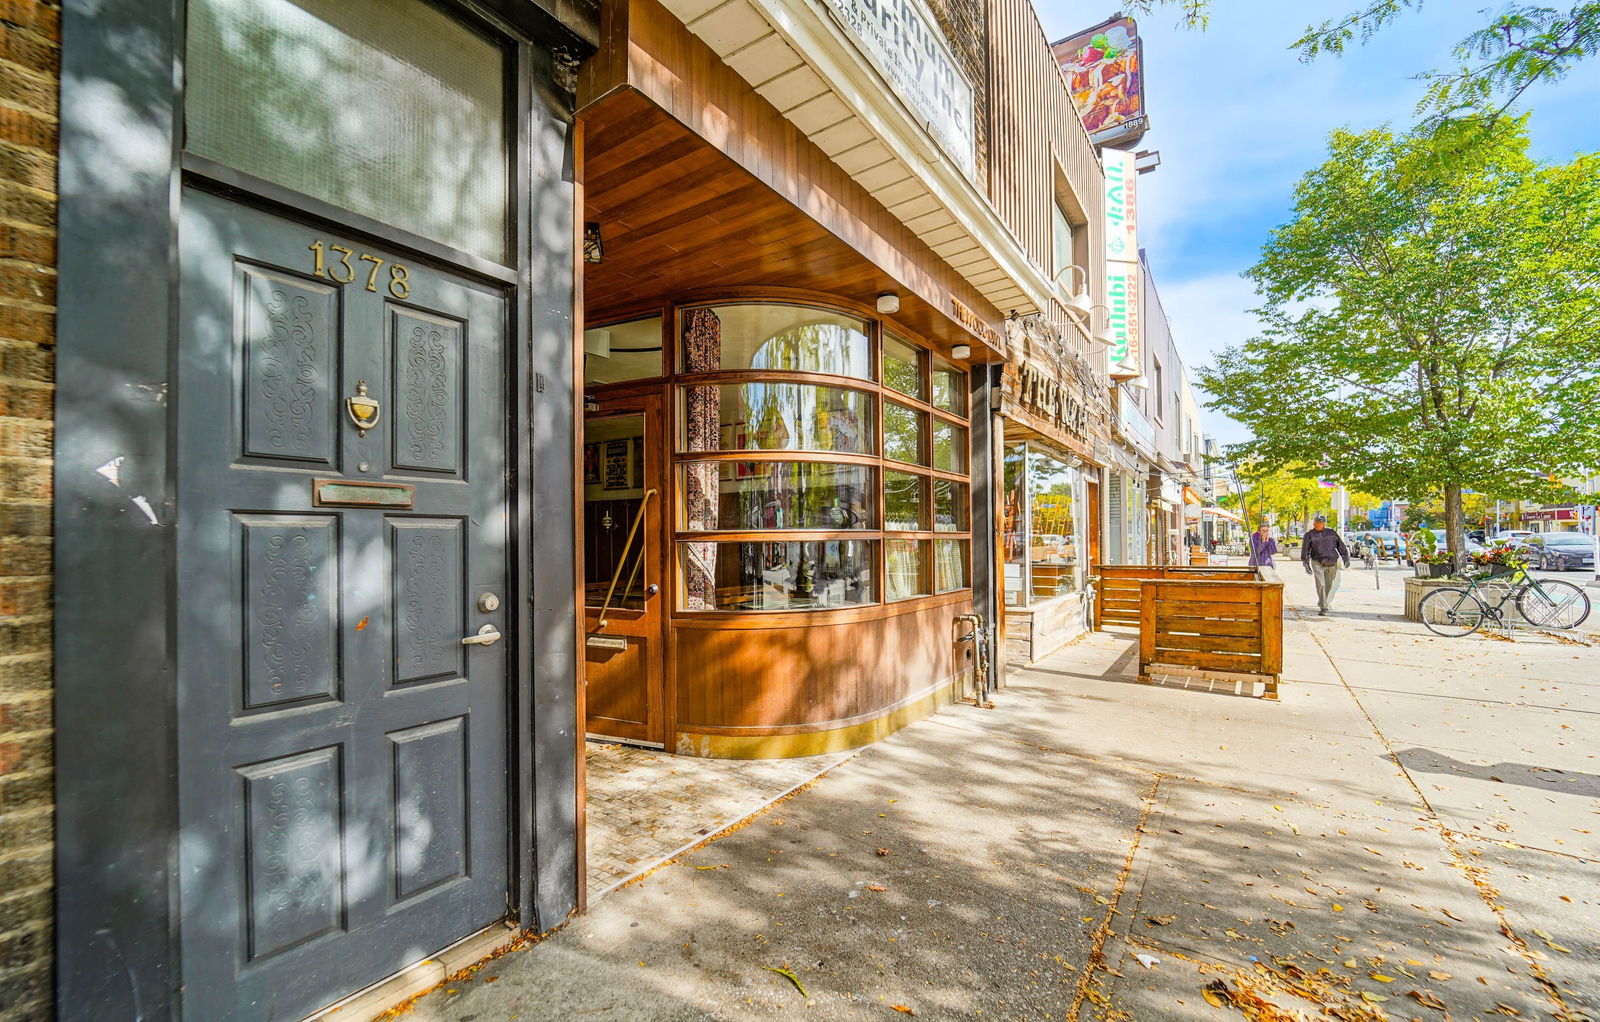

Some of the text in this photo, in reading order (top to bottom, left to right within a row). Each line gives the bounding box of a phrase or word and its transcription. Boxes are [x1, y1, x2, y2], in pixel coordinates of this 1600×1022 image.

[860, 10, 893, 60] Private
[934, 70, 968, 140] Inc.
[1125, 178, 1136, 235] 1386
[309, 239, 411, 299] 1378
[1107, 275, 1127, 363] Kullubi
[1018, 361, 1058, 418] THE
